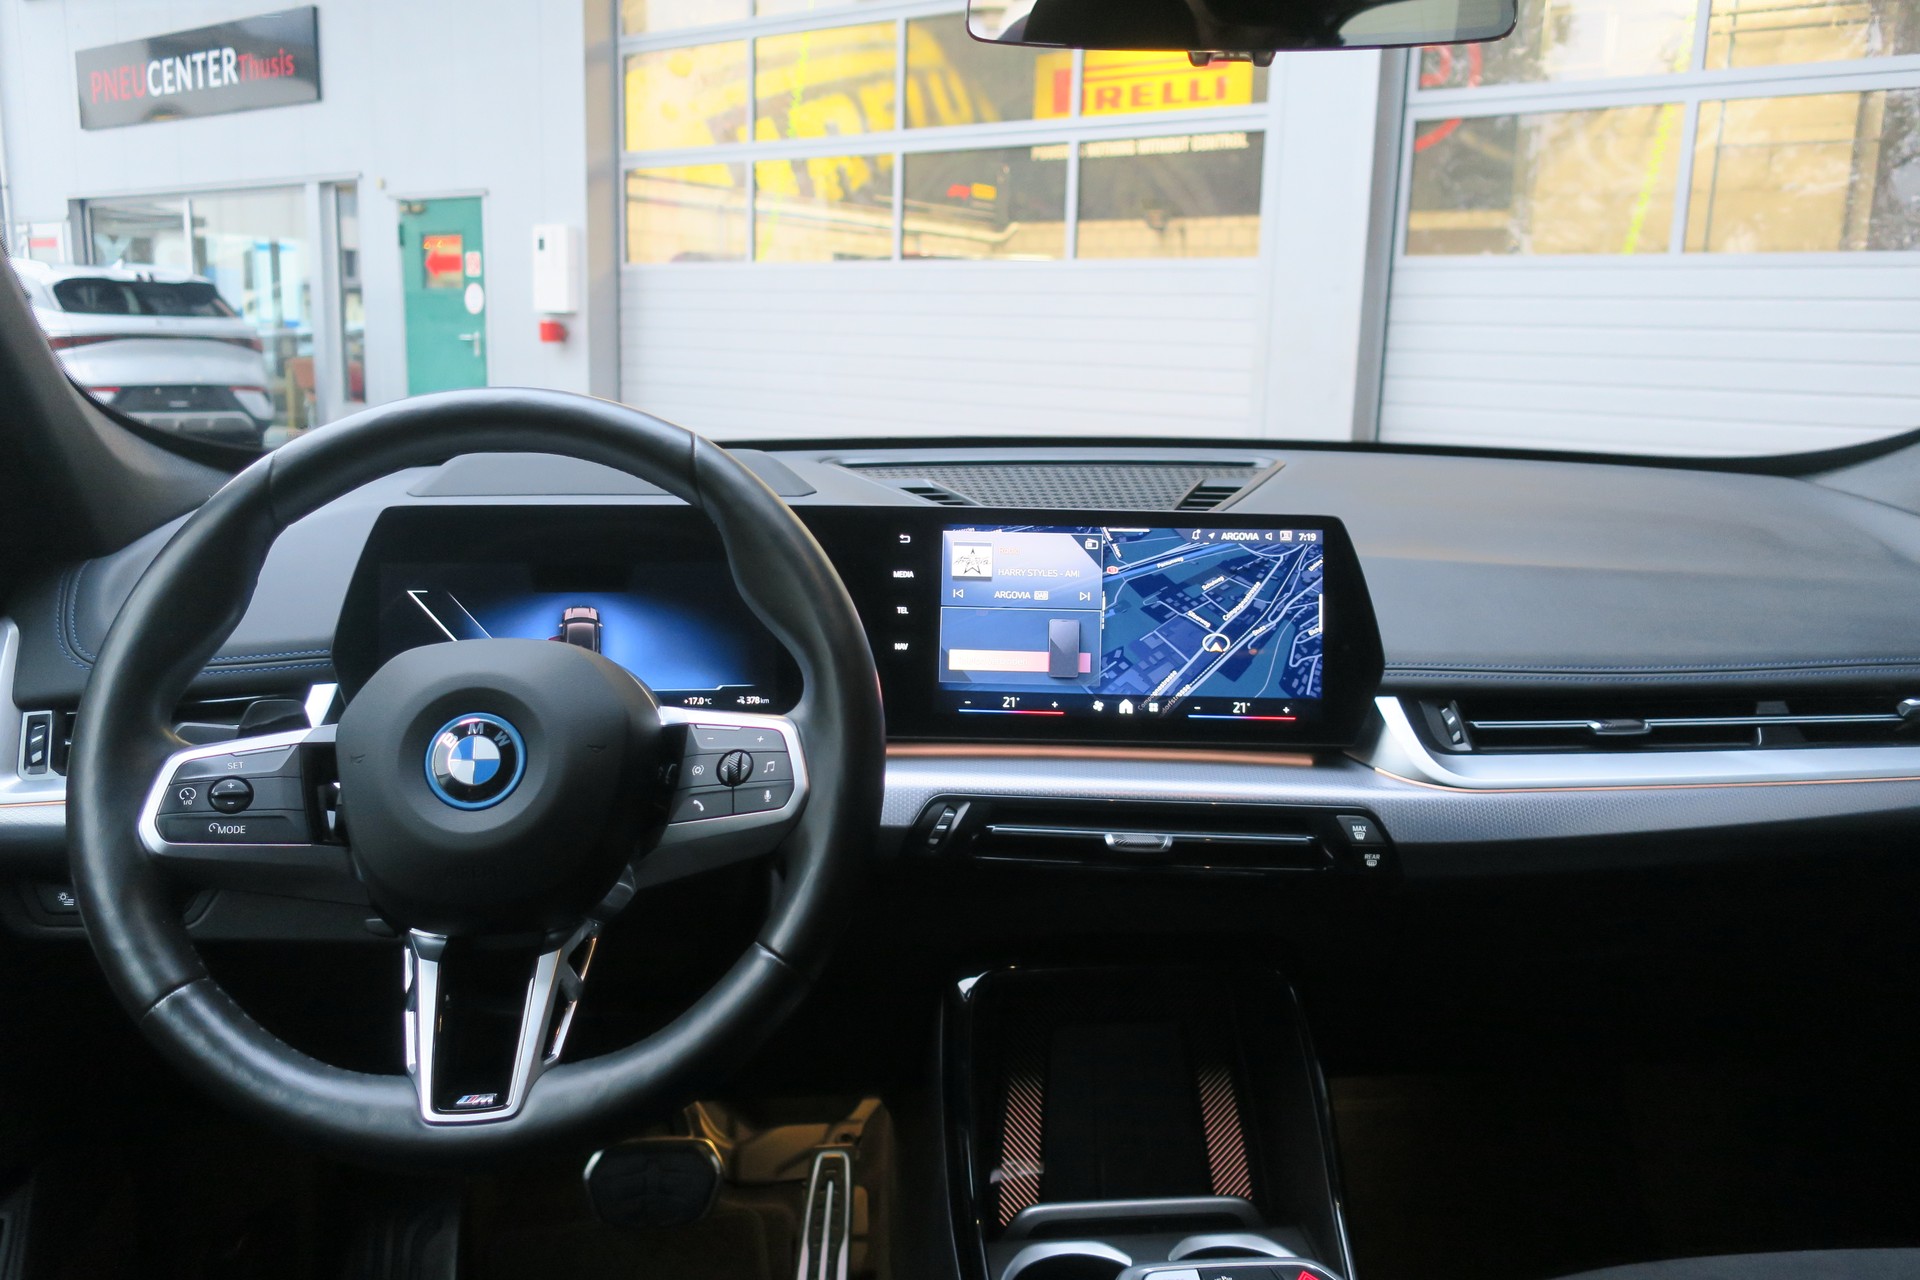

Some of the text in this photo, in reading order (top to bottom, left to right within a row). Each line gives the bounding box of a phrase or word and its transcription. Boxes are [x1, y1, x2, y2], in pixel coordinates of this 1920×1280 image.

[1221, 532, 1259, 541] ARGOVIA
[1298, 532, 1317, 541] 7:19
[893, 570, 914, 579] MEDIA
[998, 568, 1026, 577] HARRY
[1027, 568, 1058, 578] STYLES
[994, 590, 1031, 600] ARGOVIA
[896, 606, 909, 615] TEL
[894, 642, 909, 651] NAV
[441, 722, 511, 748] BMW
[227, 761, 244, 770] SET
[217, 825, 246, 835] MODE
